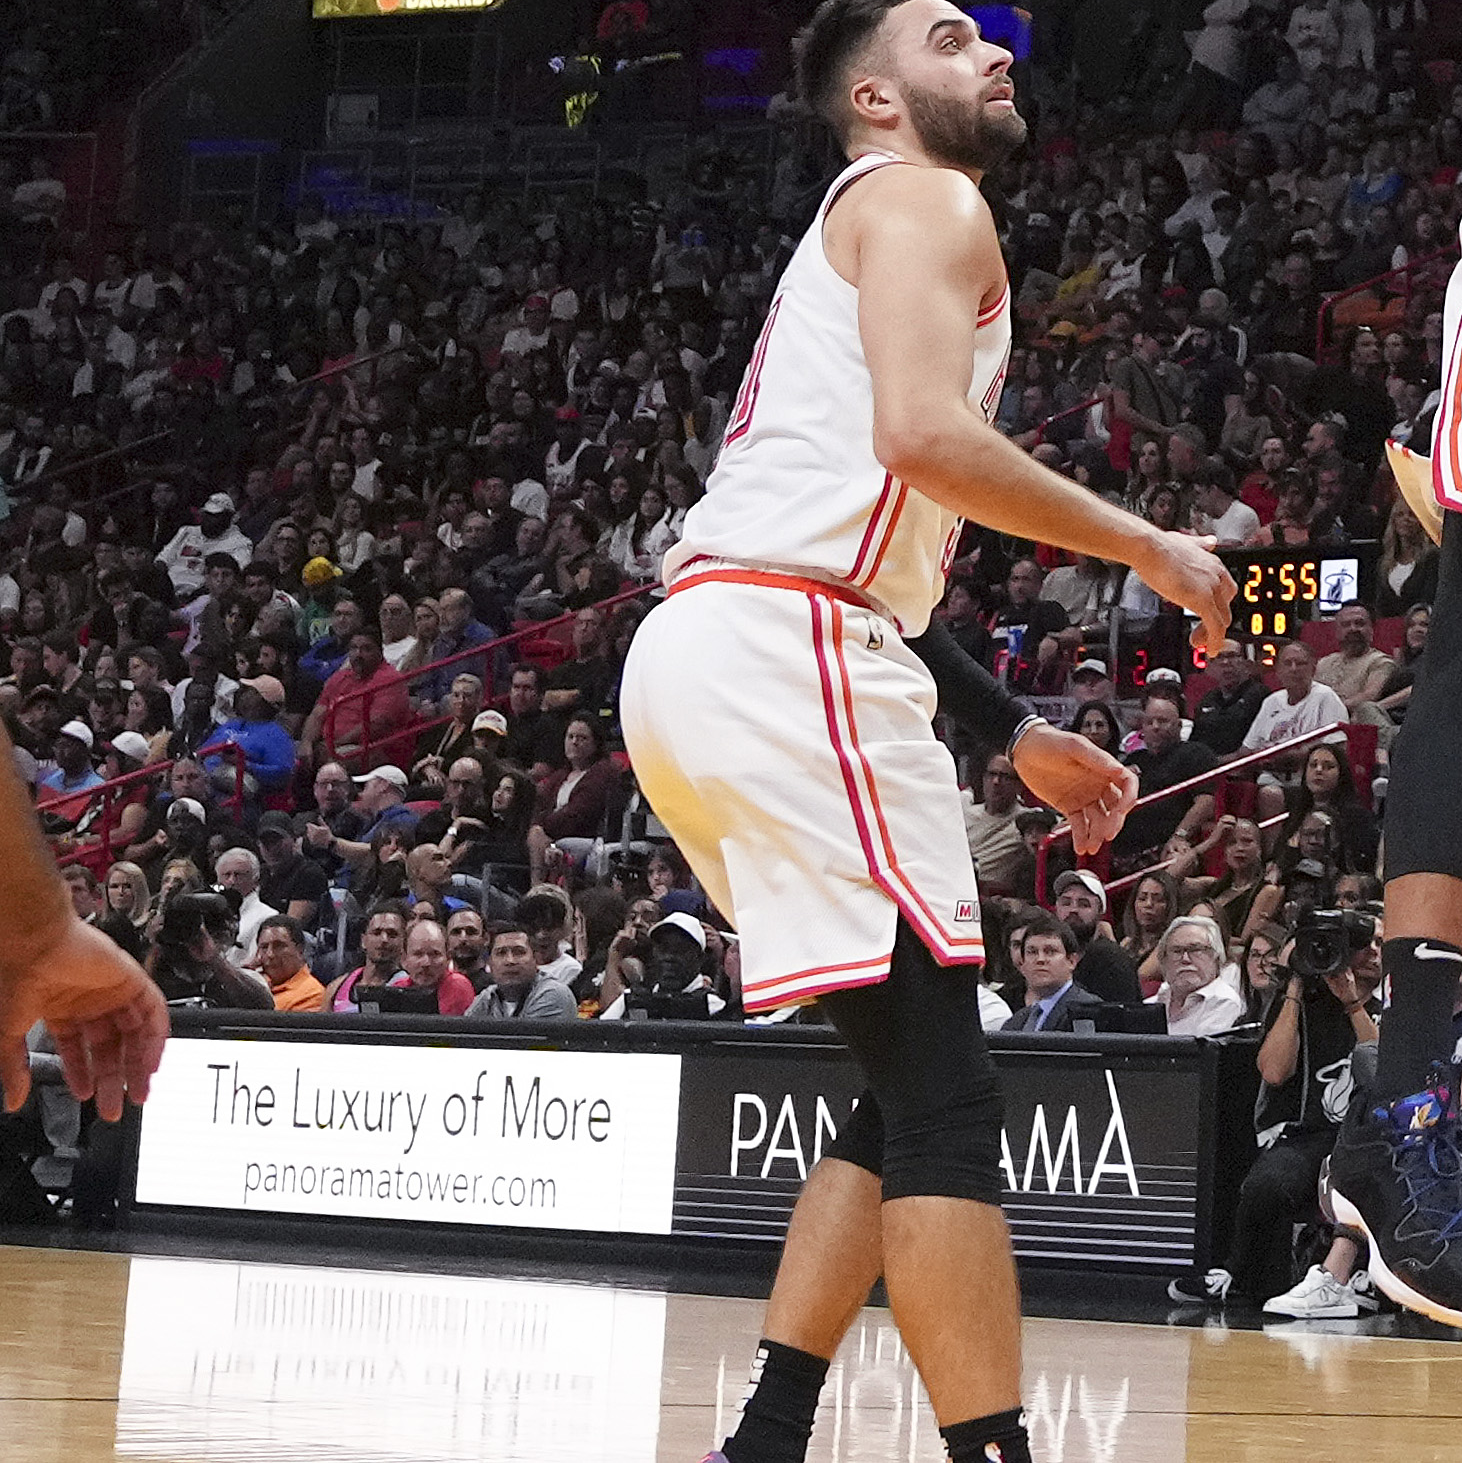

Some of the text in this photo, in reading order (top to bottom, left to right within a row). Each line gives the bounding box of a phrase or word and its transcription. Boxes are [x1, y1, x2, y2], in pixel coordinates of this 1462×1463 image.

[1244, 563, 1317, 602] 2:55
[207, 1061, 612, 1154] The Luxury of More
[243, 1159, 556, 1208] panoramatower.com
